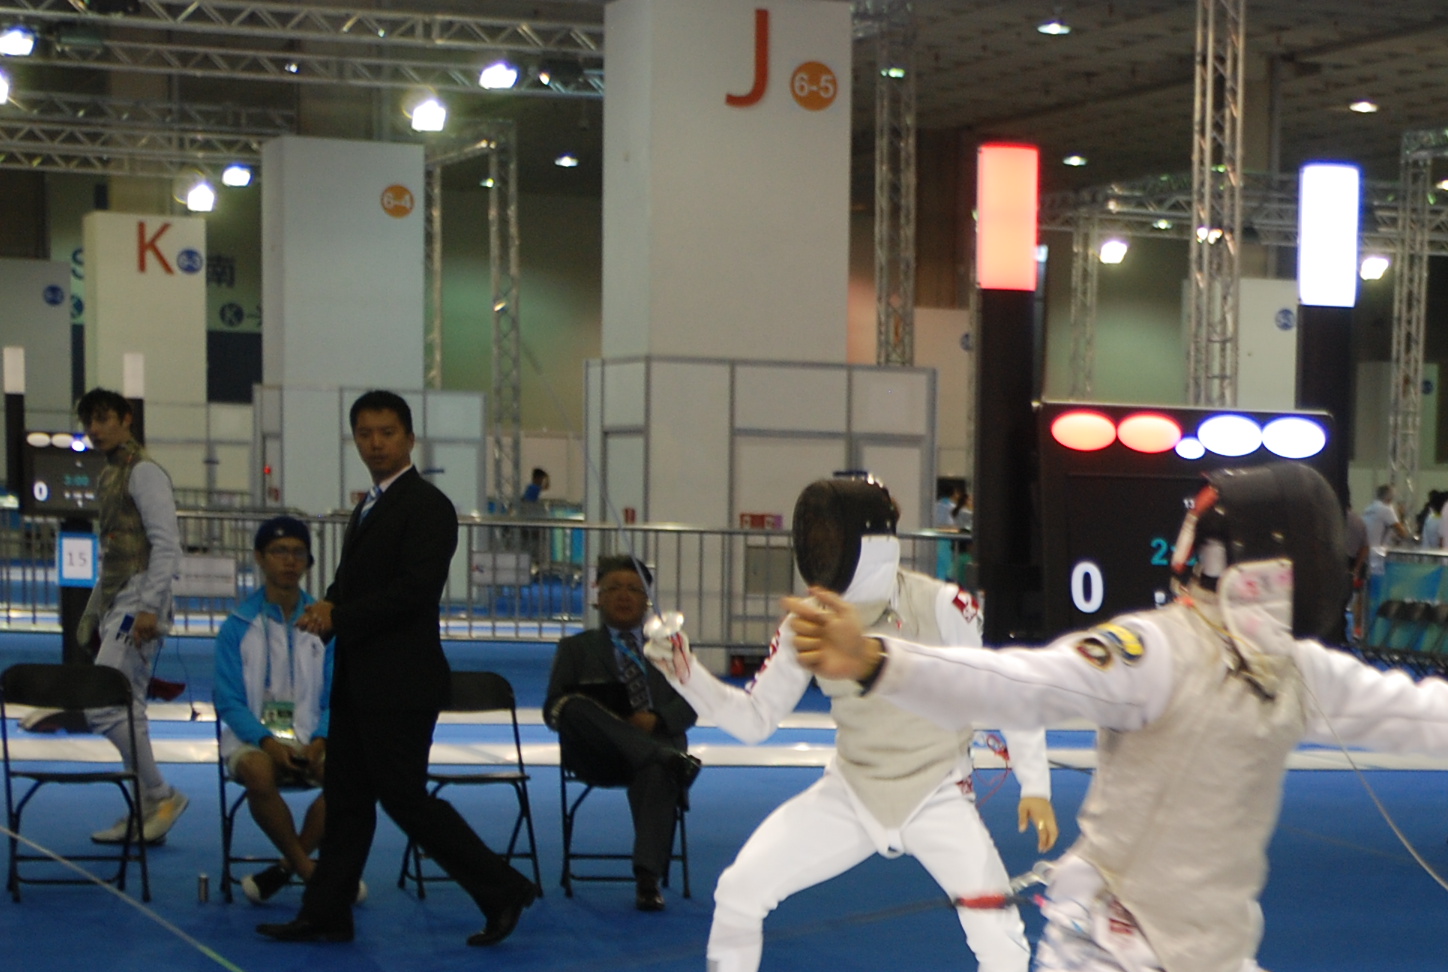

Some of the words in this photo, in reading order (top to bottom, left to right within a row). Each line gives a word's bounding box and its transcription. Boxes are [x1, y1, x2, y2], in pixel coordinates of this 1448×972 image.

[724, 8, 770, 108] J
[793, 73, 835, 99] 6-5
[136, 221, 175, 275] K
[33, 480, 49, 502] 0
[66, 551, 88, 568] 15
[1071, 560, 1104, 614] 0
